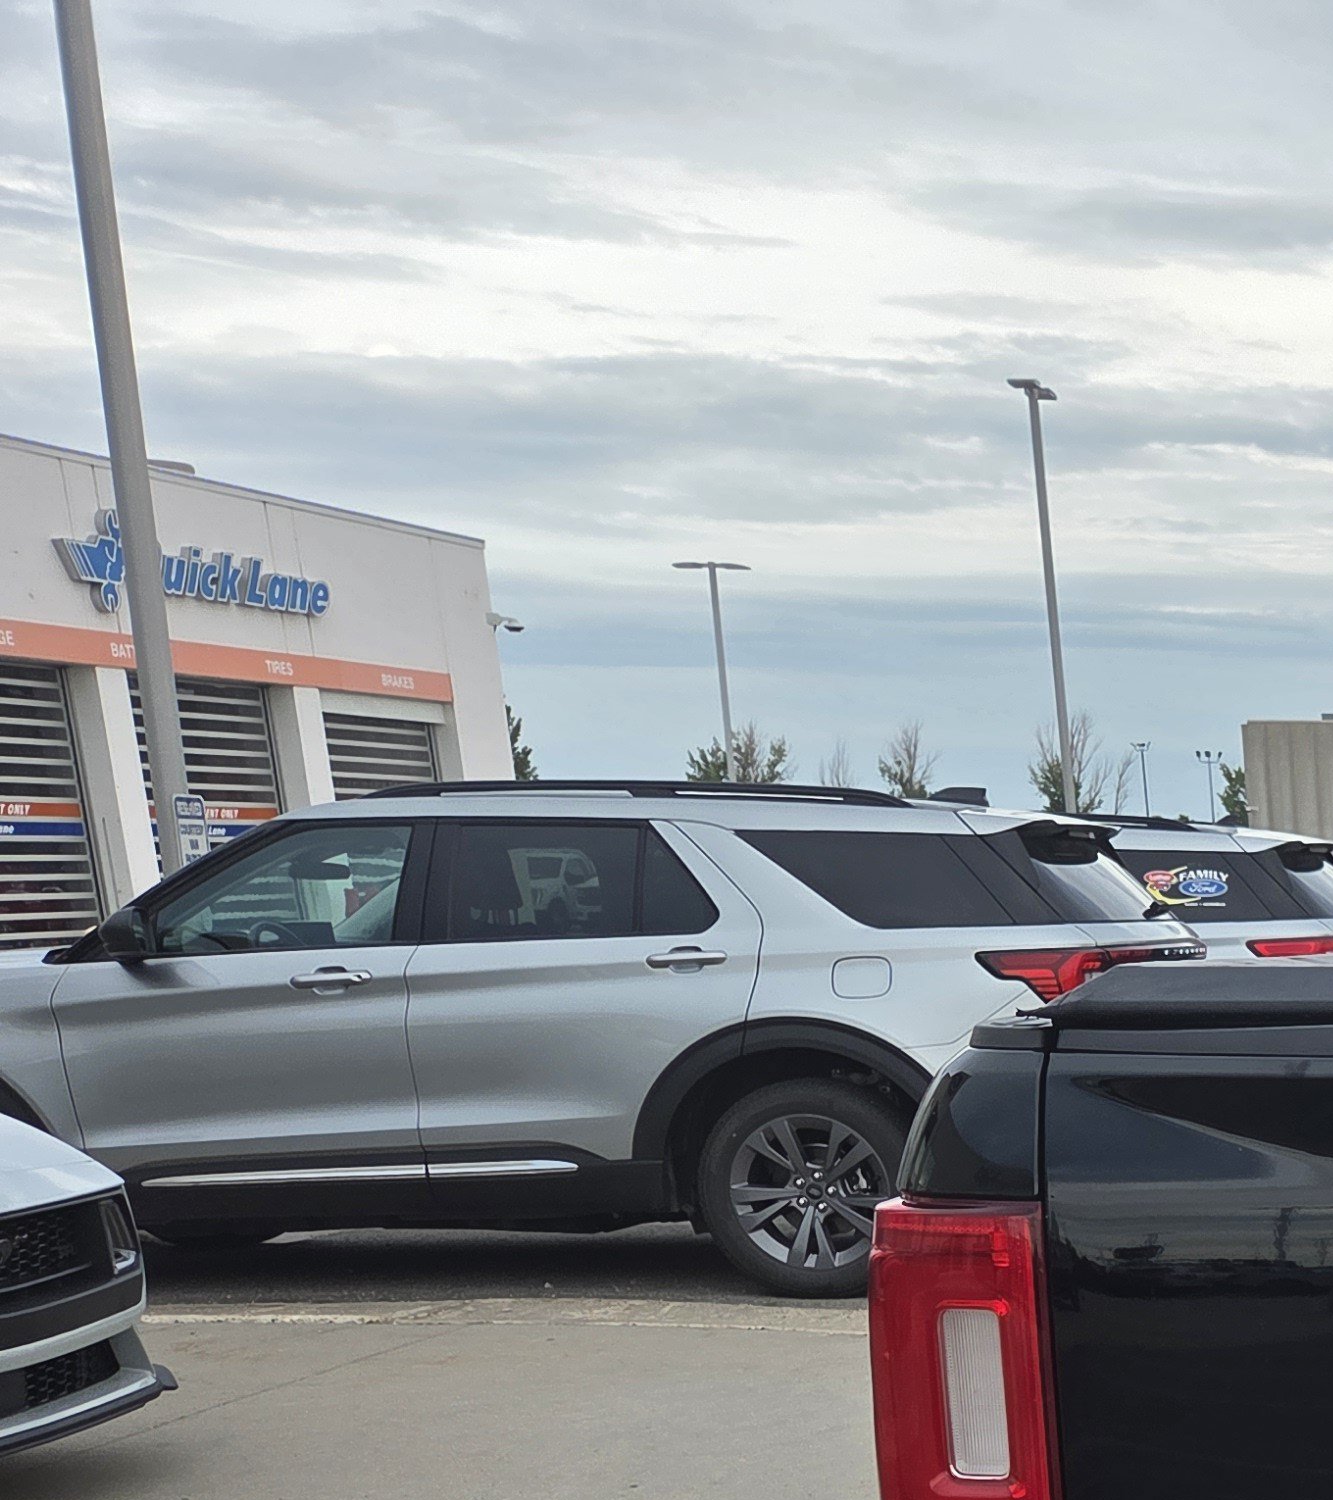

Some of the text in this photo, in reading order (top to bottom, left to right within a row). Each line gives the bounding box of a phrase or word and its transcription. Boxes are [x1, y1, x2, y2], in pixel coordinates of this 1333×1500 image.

[161, 545, 330, 617] uick Lane
[265, 660, 294, 676] TIRES
[381, 673, 415, 690] BRAKES
[1178, 869, 1229, 882] FAMILY
[1188, 882, 1218, 893] Ford
